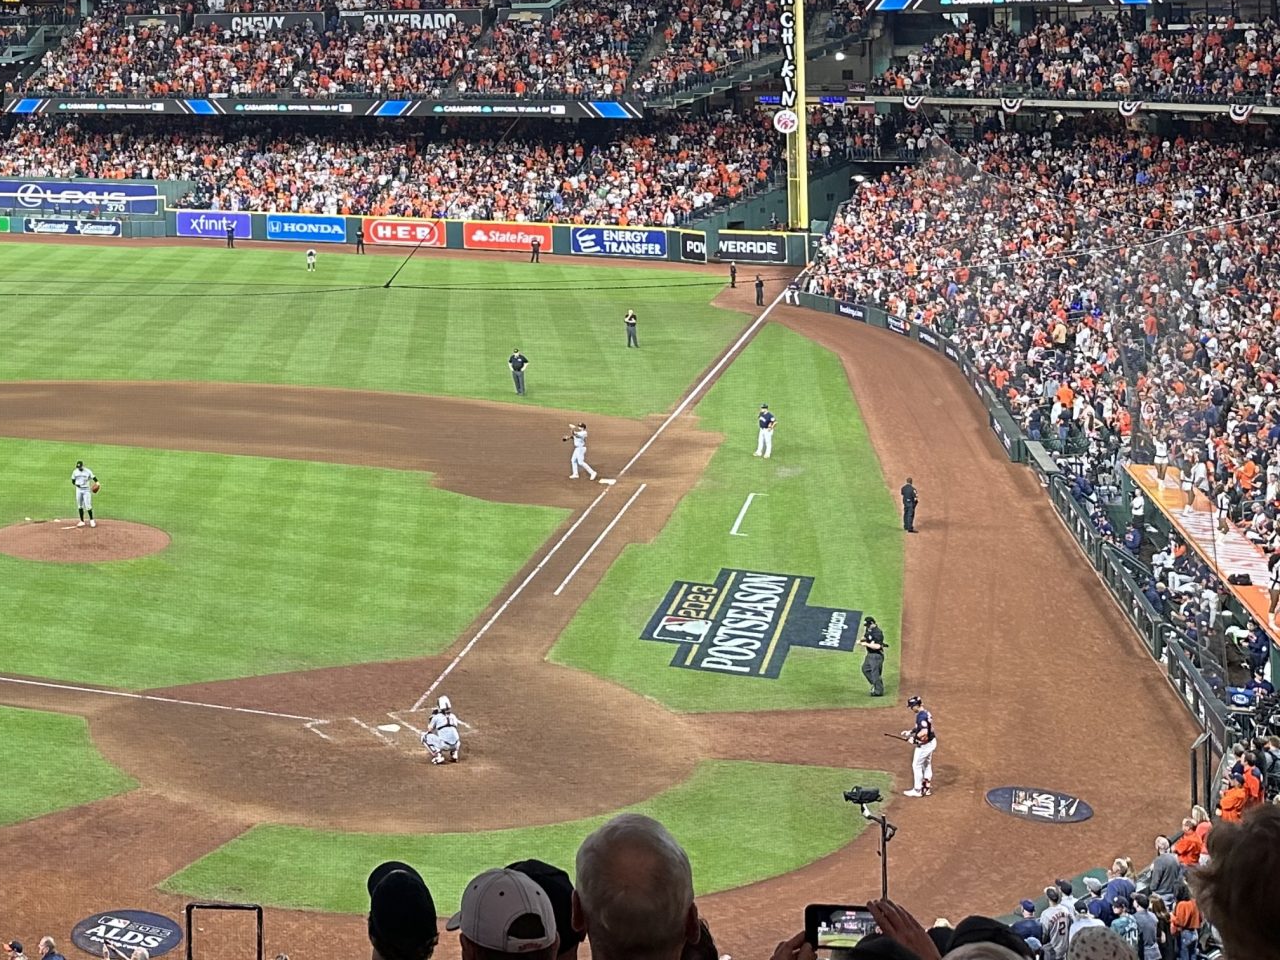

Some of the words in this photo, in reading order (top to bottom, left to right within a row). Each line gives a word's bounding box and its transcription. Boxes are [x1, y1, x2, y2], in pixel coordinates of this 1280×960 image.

[778, 10, 797, 108] CHIKIN
[107, 203, 125, 212] 370
[282, 222, 344, 235] HONDA
[603, 230, 648, 243] ENERGY
[603, 242, 661, 256] TRANSFER
[677, 585, 718, 618] 2023
[700, 573, 788, 673] POSTSEASON
[85, 924, 164, 949] ALDS
